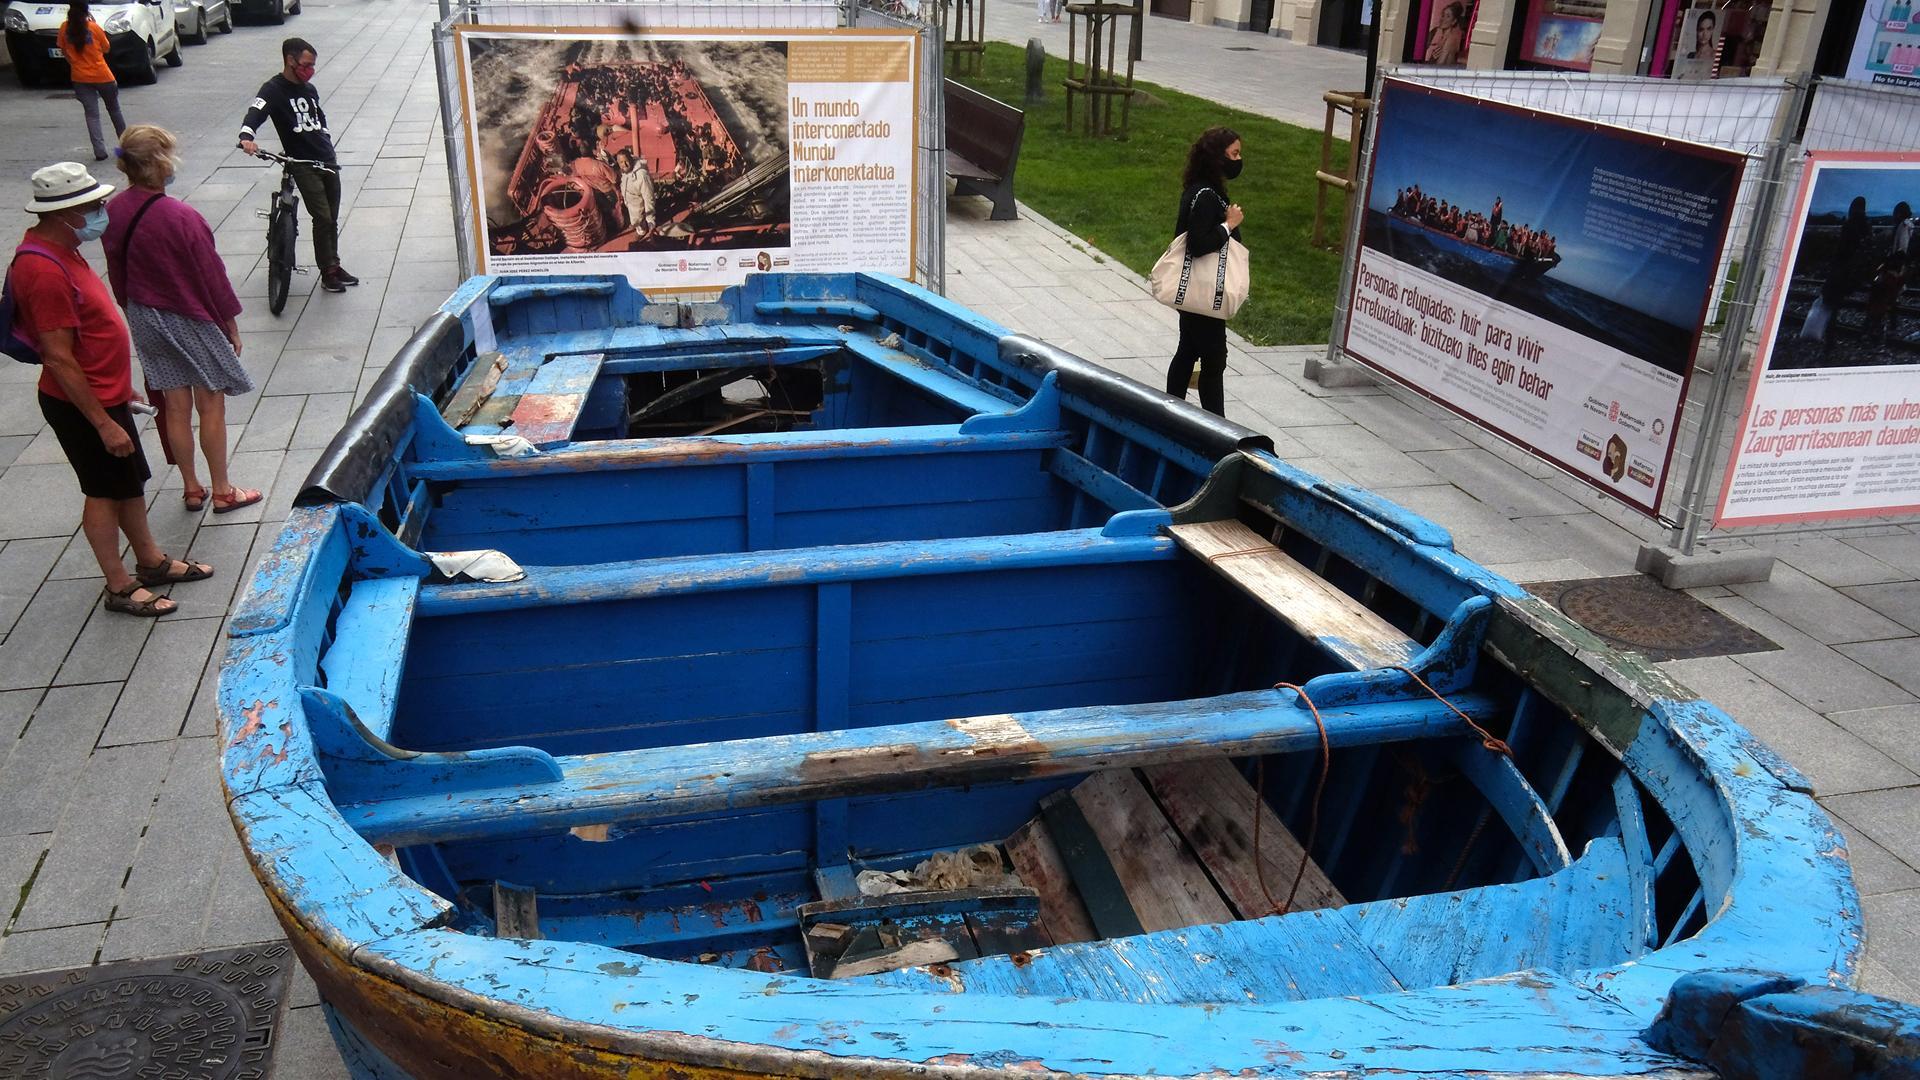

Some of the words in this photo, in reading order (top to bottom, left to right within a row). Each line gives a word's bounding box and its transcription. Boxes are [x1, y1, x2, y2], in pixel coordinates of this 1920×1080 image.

[793, 97, 807, 117] Un
[815, 99, 859, 117] mundo
[793, 120, 890, 139] interconectado
[793, 142, 835, 161] Mundu
[794, 164, 895, 182] interkonektatua
[1359, 263, 1398, 300] Personas
[1401, 287, 1455, 324] refugiadas:
[1460, 311, 1481, 336] huir
[1485, 324, 1512, 351] para
[1517, 336, 1544, 364] vivir
[1355, 290, 1417, 336] Errefuxiatuak:
[1421, 322, 1463, 360] bizitzeko
[1467, 343, 1488, 371] ihes
[1492, 357, 1515, 385] egin
[1519, 371, 1553, 401] behar
[1588, 396, 1608, 409] Gobierno
[1590, 405, 1607, 417] Navarra
[1752, 404, 1775, 428] Las
[1780, 405, 1845, 430] personas
[1848, 402, 1878, 423] más
[1583, 434, 1600, 446] Navarra
[1744, 430, 1872, 458] Zaurgarritasunean
